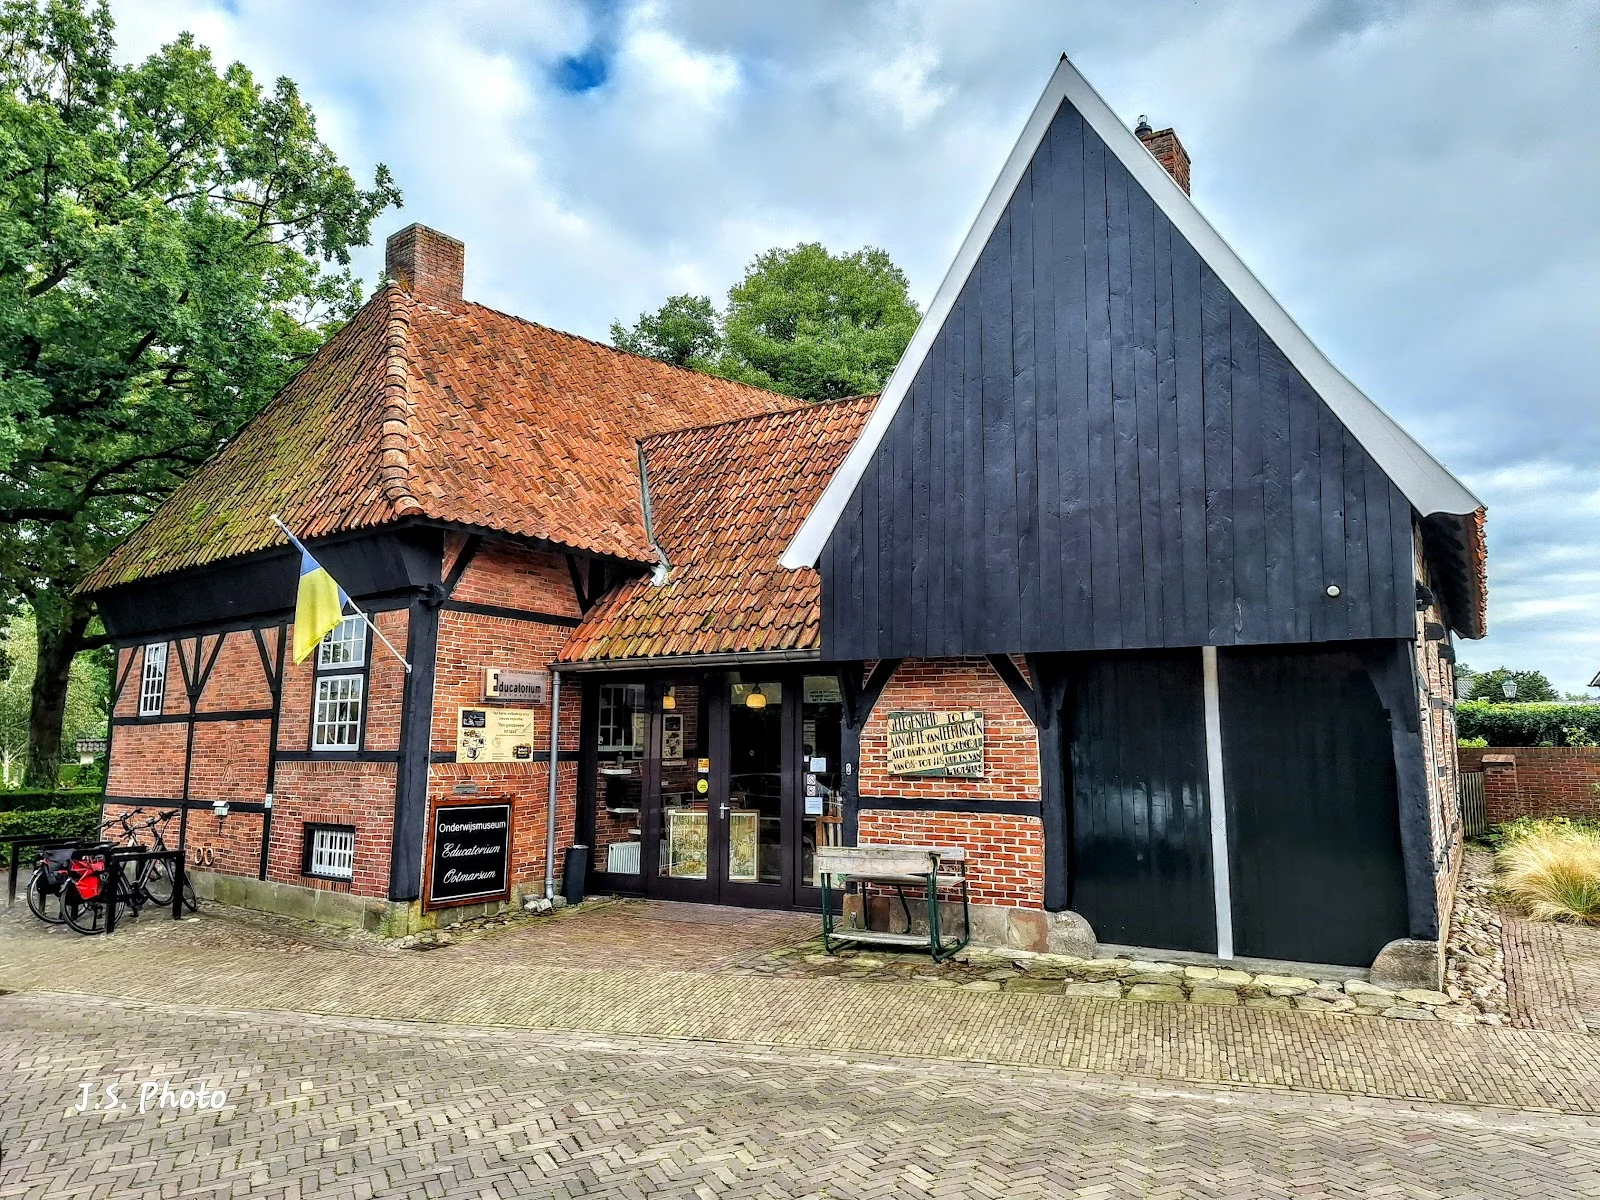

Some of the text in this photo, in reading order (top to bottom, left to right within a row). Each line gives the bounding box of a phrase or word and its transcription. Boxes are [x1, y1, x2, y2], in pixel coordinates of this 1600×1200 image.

[947, 711, 965, 723] TOT
[924, 732, 940, 744] VAN
[892, 738, 978, 759] ALLE DAGEN AAN DE SCHOOL
[893, 763, 905, 771] VAN
[918, 758, 932, 768] TOT
[958, 753, 967, 762] EN
[968, 751, 982, 761] VAN
[953, 766, 965, 775] TOT
[439, 821, 506, 833] Onderwijsmuseum
[441, 842, 500, 858] Educatorium
[443, 868, 496, 884] Ootmarsum
